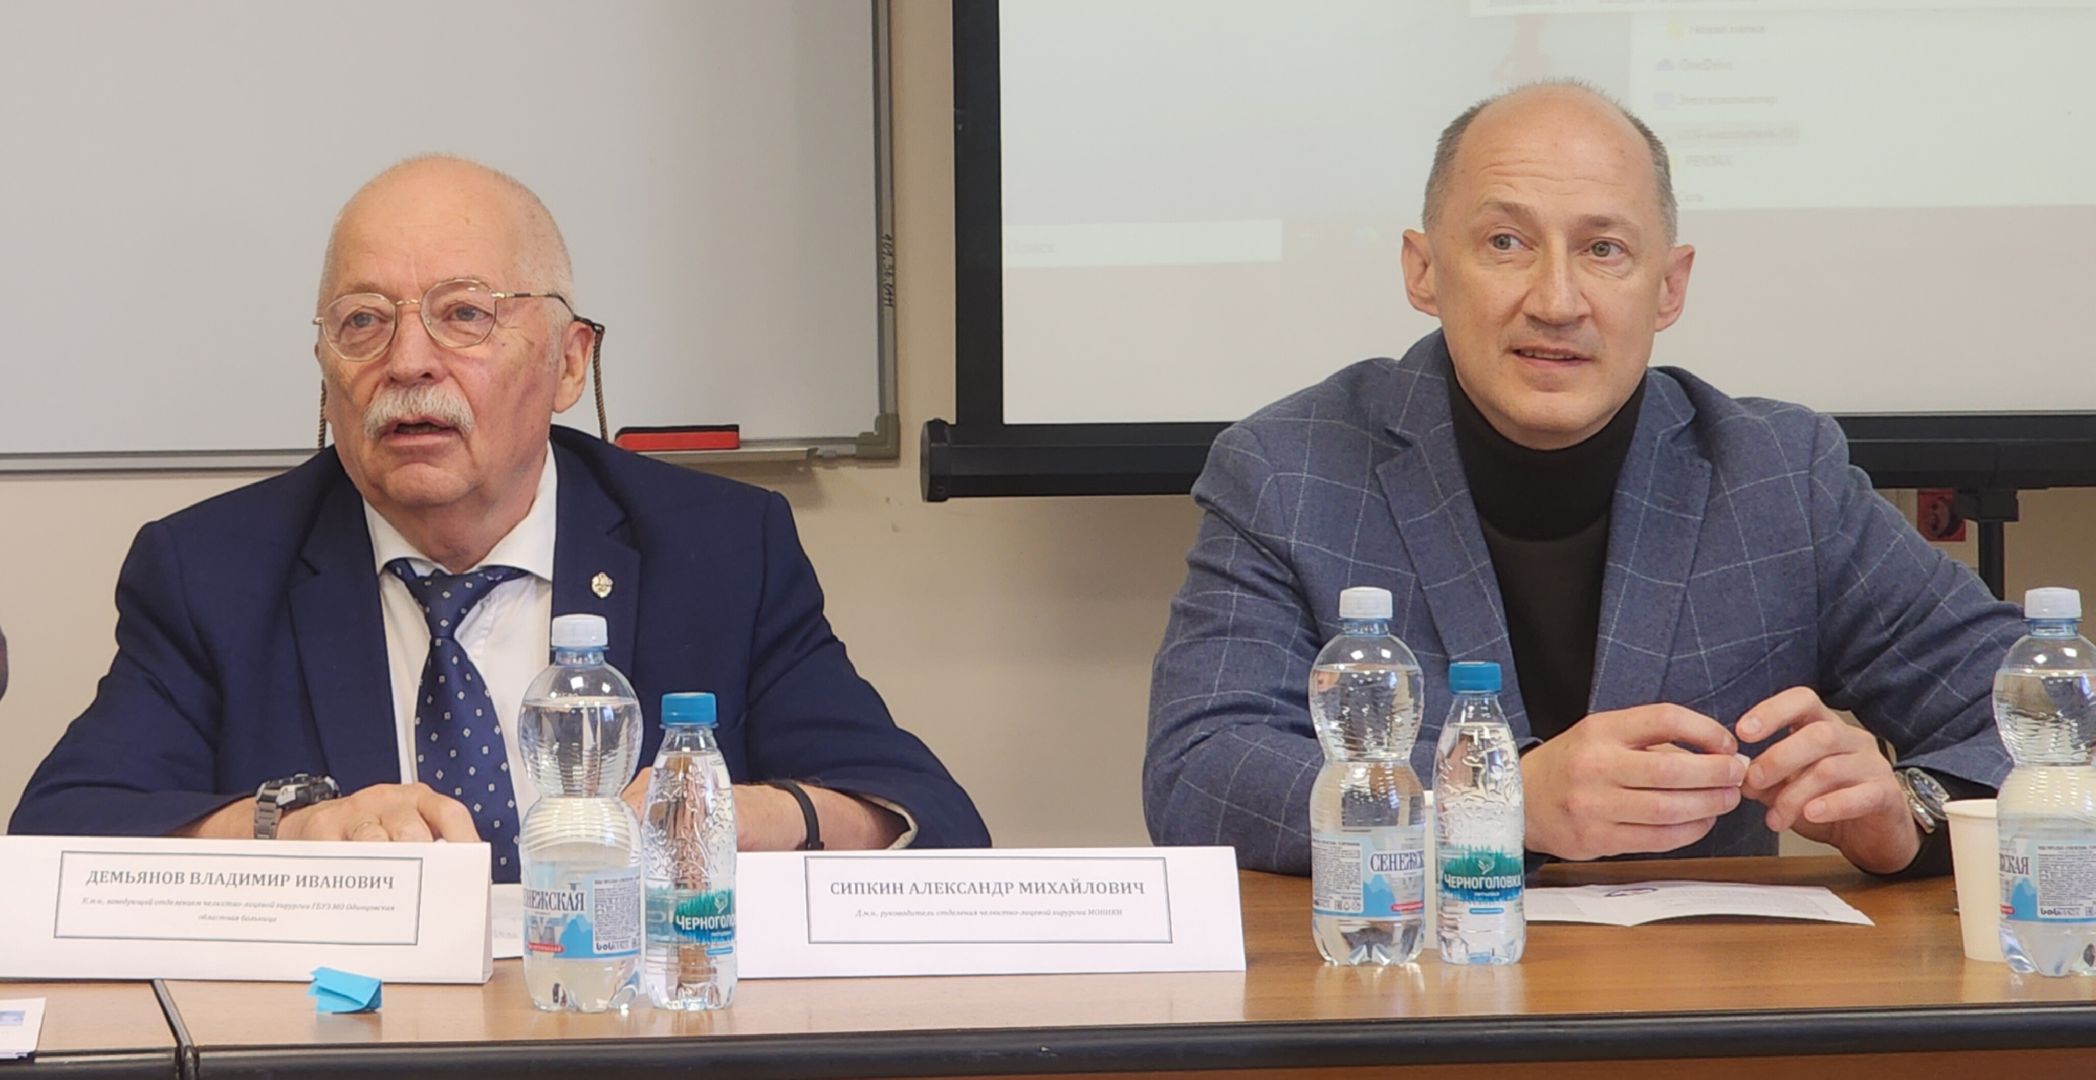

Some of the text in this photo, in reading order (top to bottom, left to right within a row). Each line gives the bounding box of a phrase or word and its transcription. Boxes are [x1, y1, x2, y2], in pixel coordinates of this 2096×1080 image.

[85, 869, 396, 890] ДЕМЬЯНОВ ВЛАДИМИР ИВАНОВИЧ
[829, 878, 1146, 898] СИПКИН АЛЕКСАНДР МИХАЙЛОВИЧ
